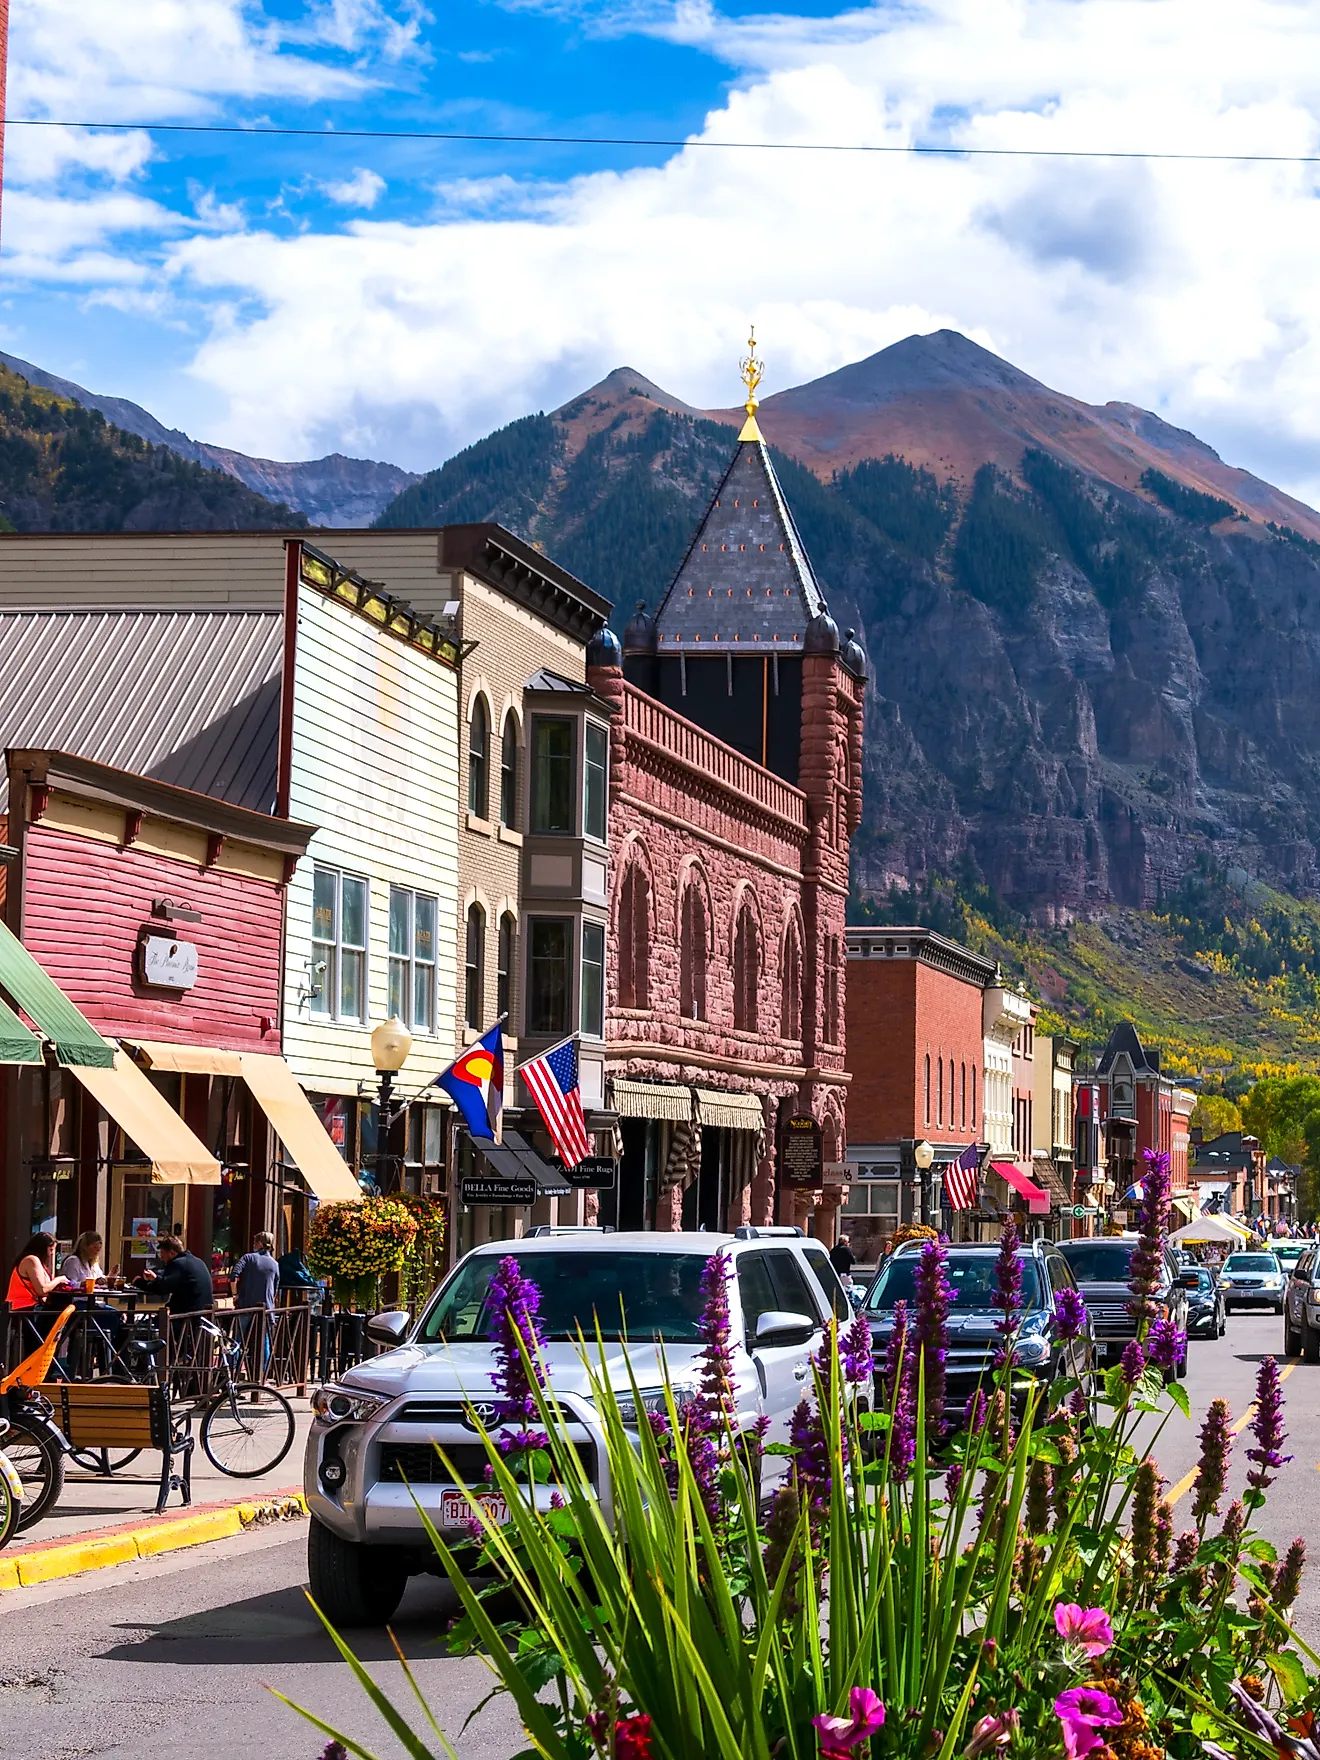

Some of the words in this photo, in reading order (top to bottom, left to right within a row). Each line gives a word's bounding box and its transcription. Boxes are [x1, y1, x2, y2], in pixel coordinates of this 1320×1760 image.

[580, 1165, 595, 1173] Fine
[596, 1165, 614, 1174] Rugs
[464, 1183, 492, 1192] BELLA
[493, 1183, 510, 1192] Fine
[510, 1184, 534, 1193] Goods
